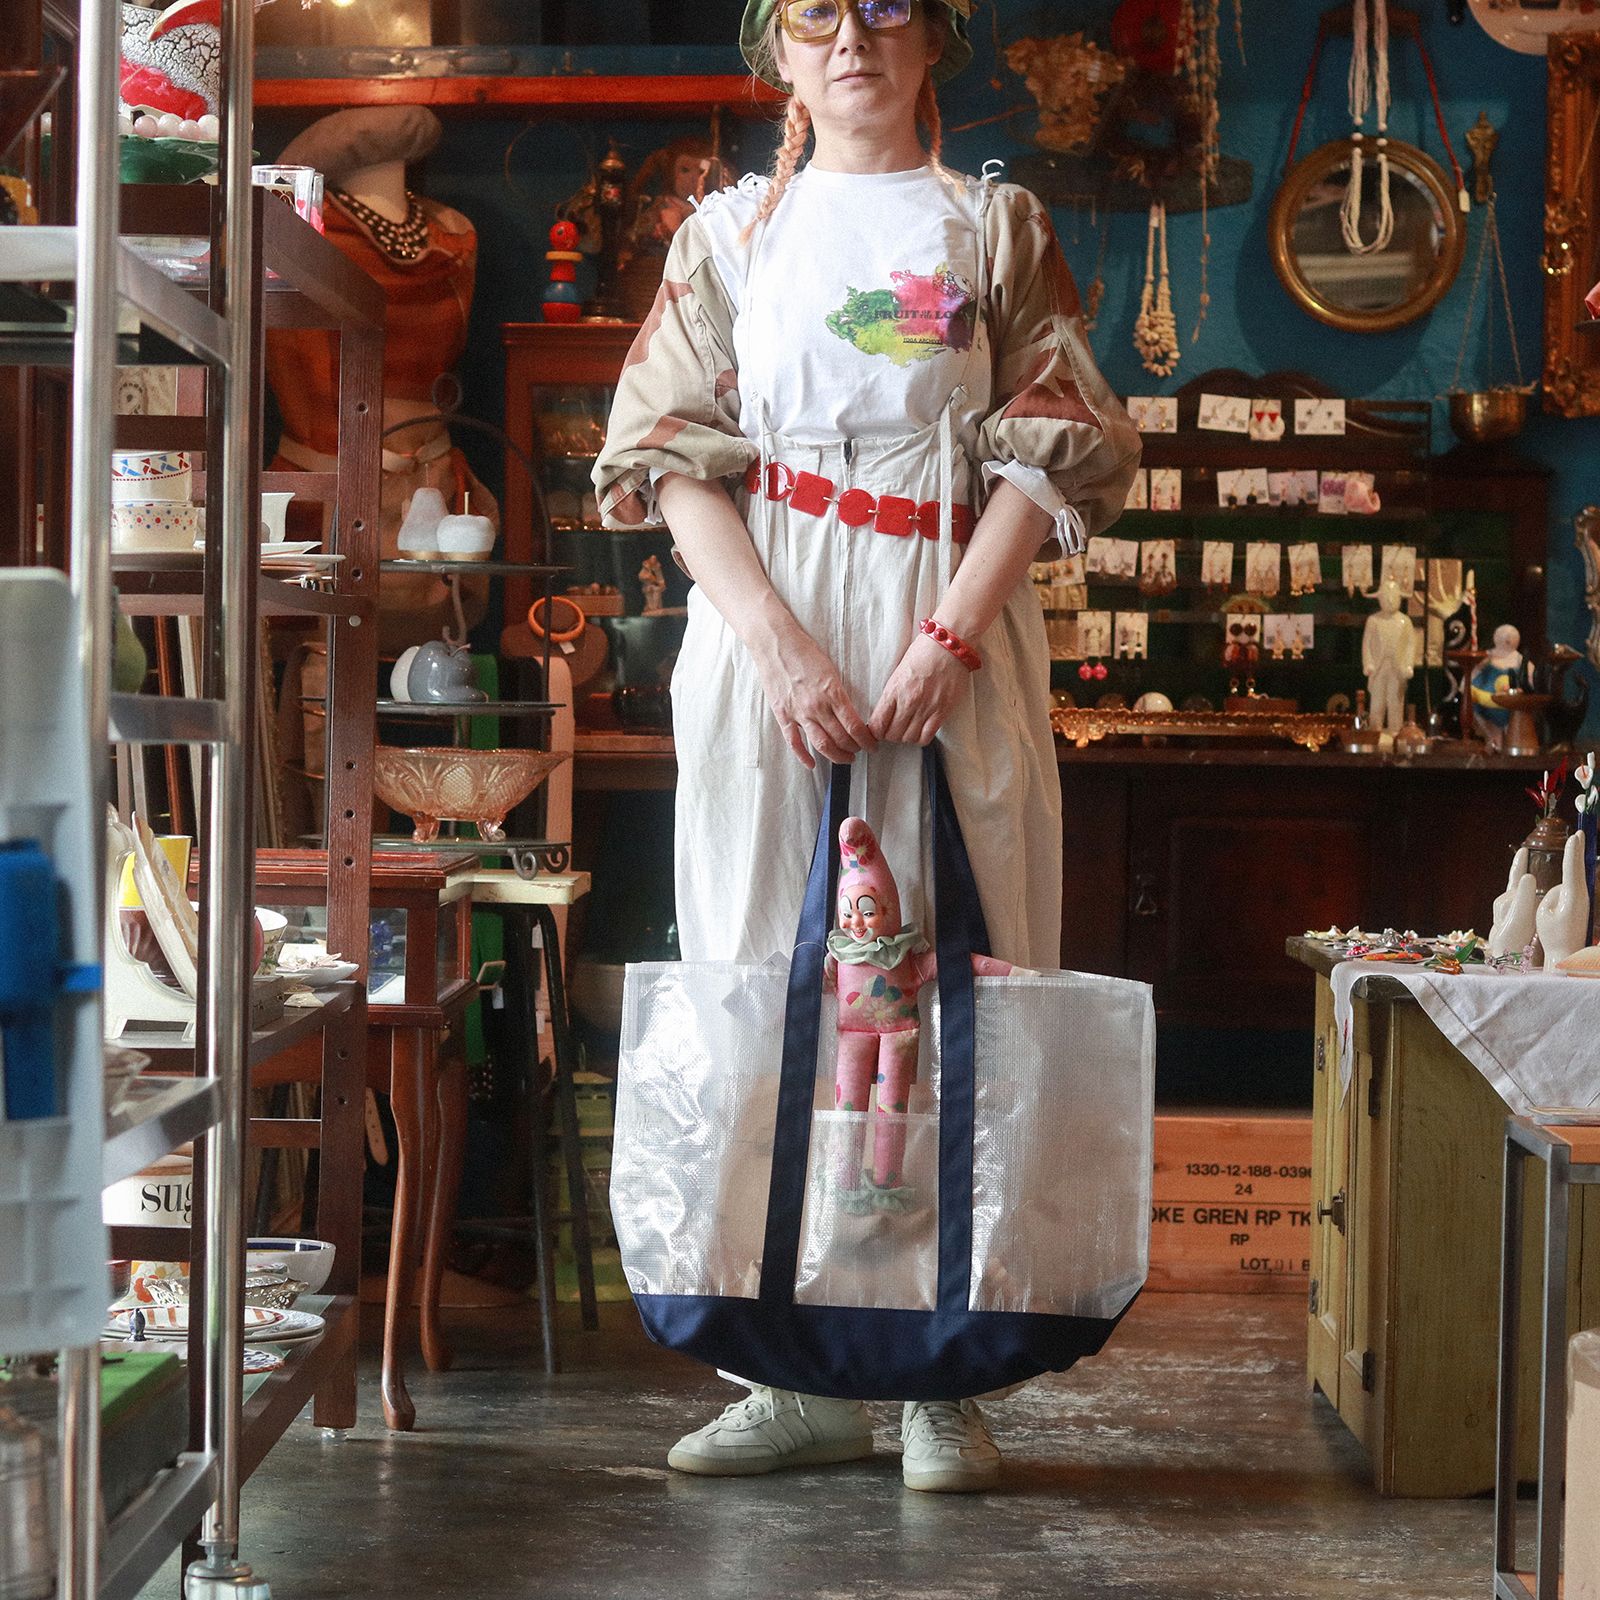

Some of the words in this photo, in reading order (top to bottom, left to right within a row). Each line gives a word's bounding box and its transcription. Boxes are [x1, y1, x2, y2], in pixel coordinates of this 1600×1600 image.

[1234, 1183, 1253, 1196] 24
[1193, 1208, 1249, 1225] GREN
[1255, 1209, 1281, 1226] RP
[1230, 1233, 1250, 1246] RP
